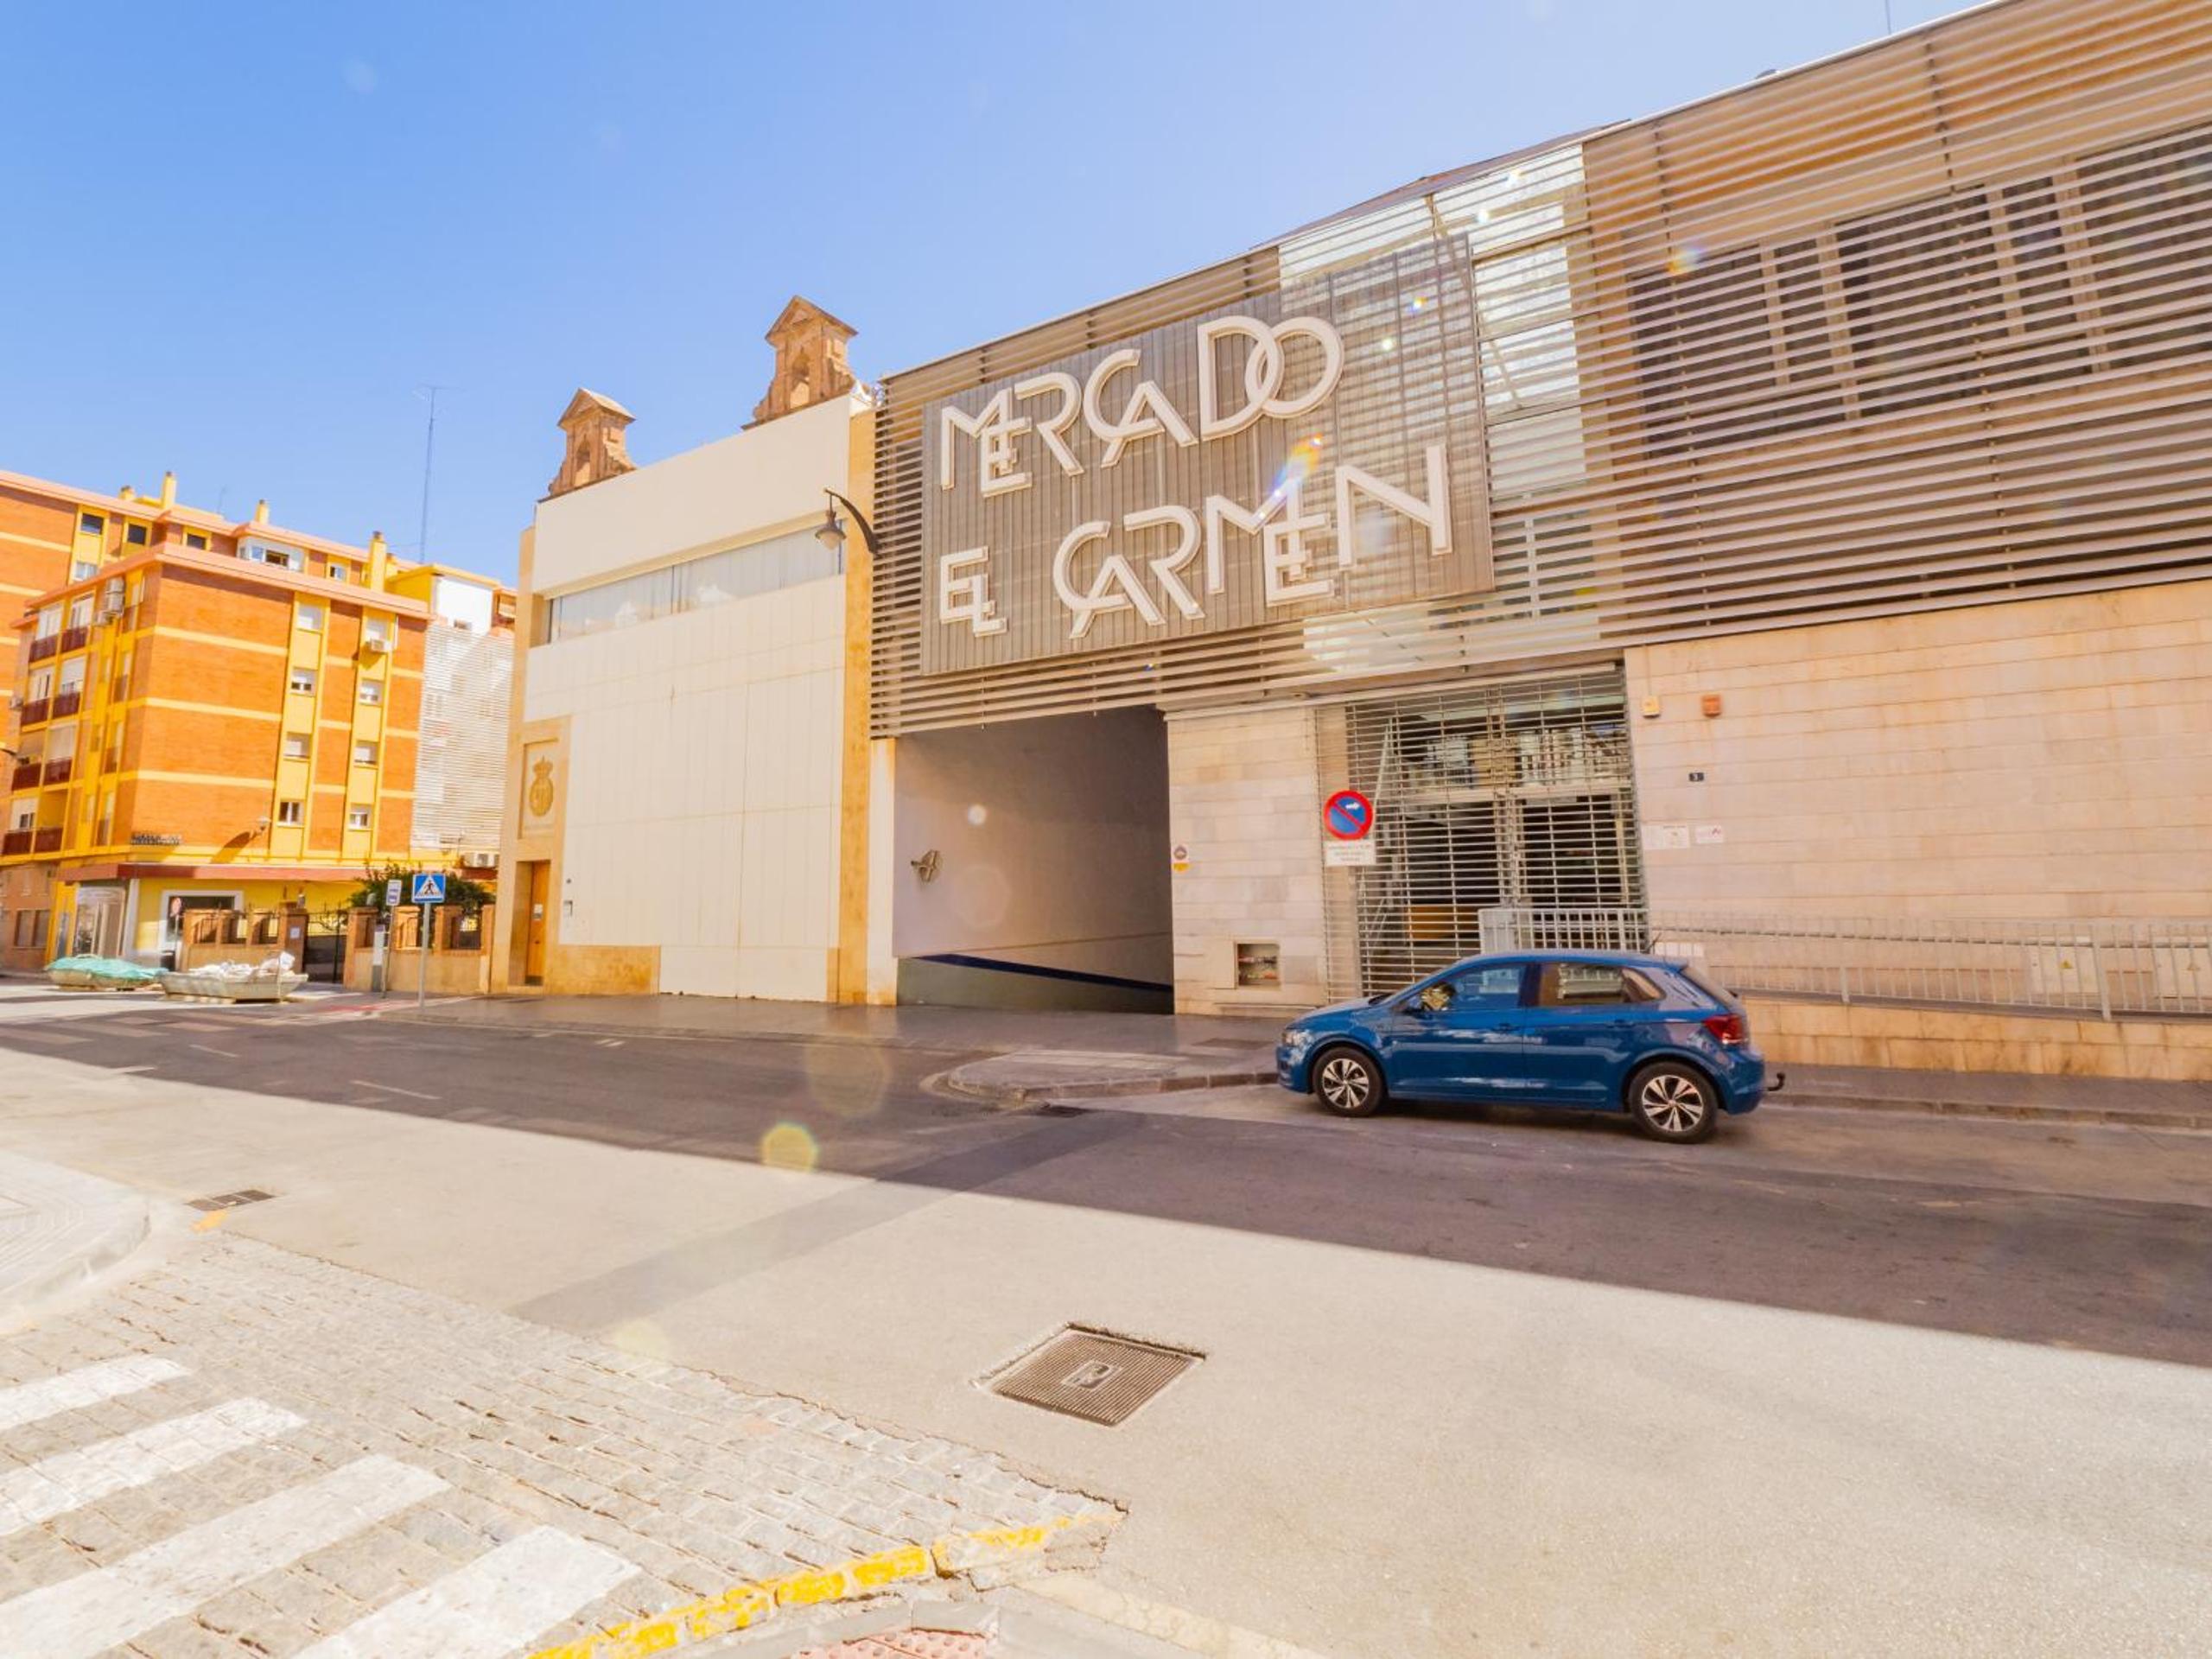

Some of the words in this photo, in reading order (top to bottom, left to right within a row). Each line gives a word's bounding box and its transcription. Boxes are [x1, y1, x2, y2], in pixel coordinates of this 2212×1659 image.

[940, 315, 1345, 498] MERCADO
[939, 545, 1007, 638] EL
[1052, 442, 1453, 640] CARMEN
